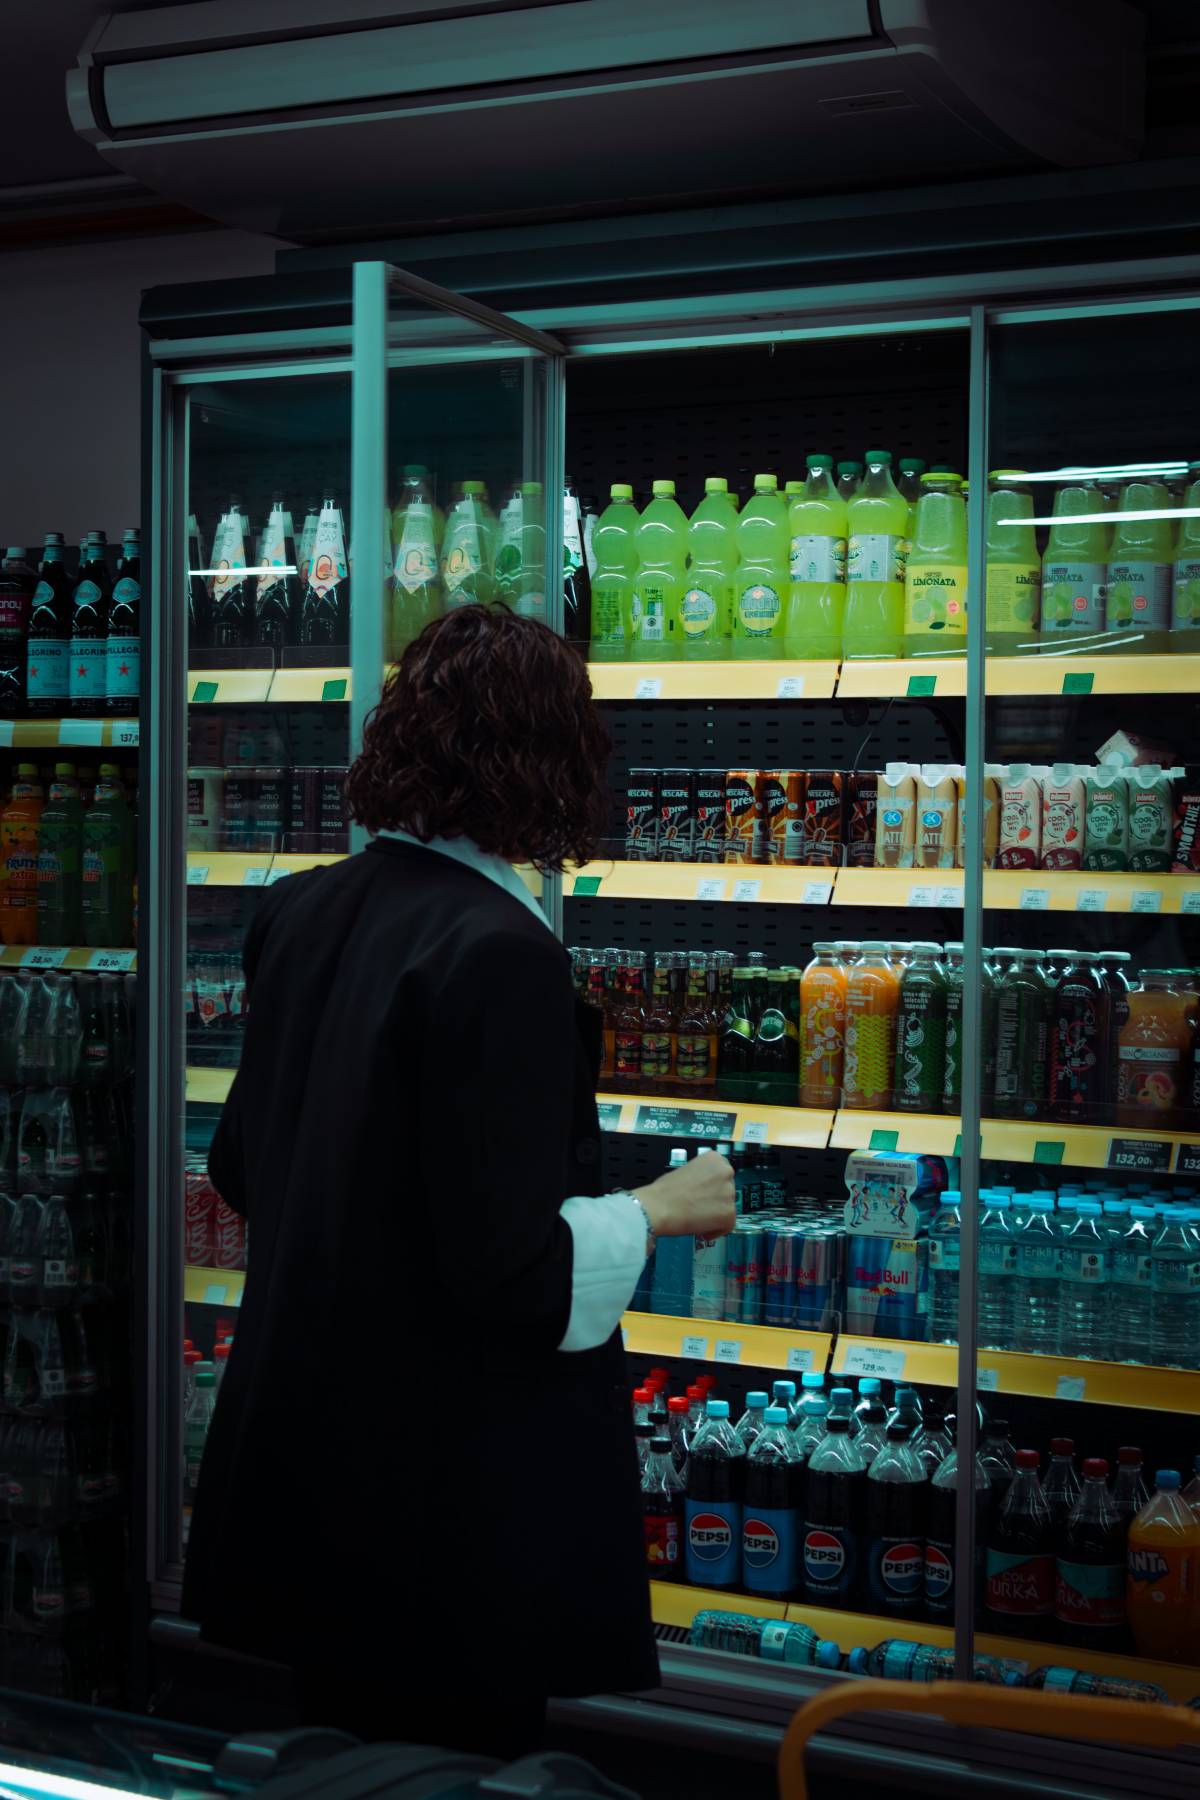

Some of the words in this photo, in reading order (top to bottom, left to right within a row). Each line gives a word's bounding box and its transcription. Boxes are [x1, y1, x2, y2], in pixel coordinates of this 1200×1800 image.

[1176, 804, 1200, 862] SMOOTHIE
[883, 1269, 909, 1285] Bull
[691, 1529, 729, 1543] PEPSI
[744, 1534, 776, 1551] PEPSI
[806, 1548, 842, 1563] PEPSI
[1128, 1552, 1169, 1573] ANTA
[885, 1561, 924, 1575] PEPS
[926, 1563, 950, 1581] EPSI
